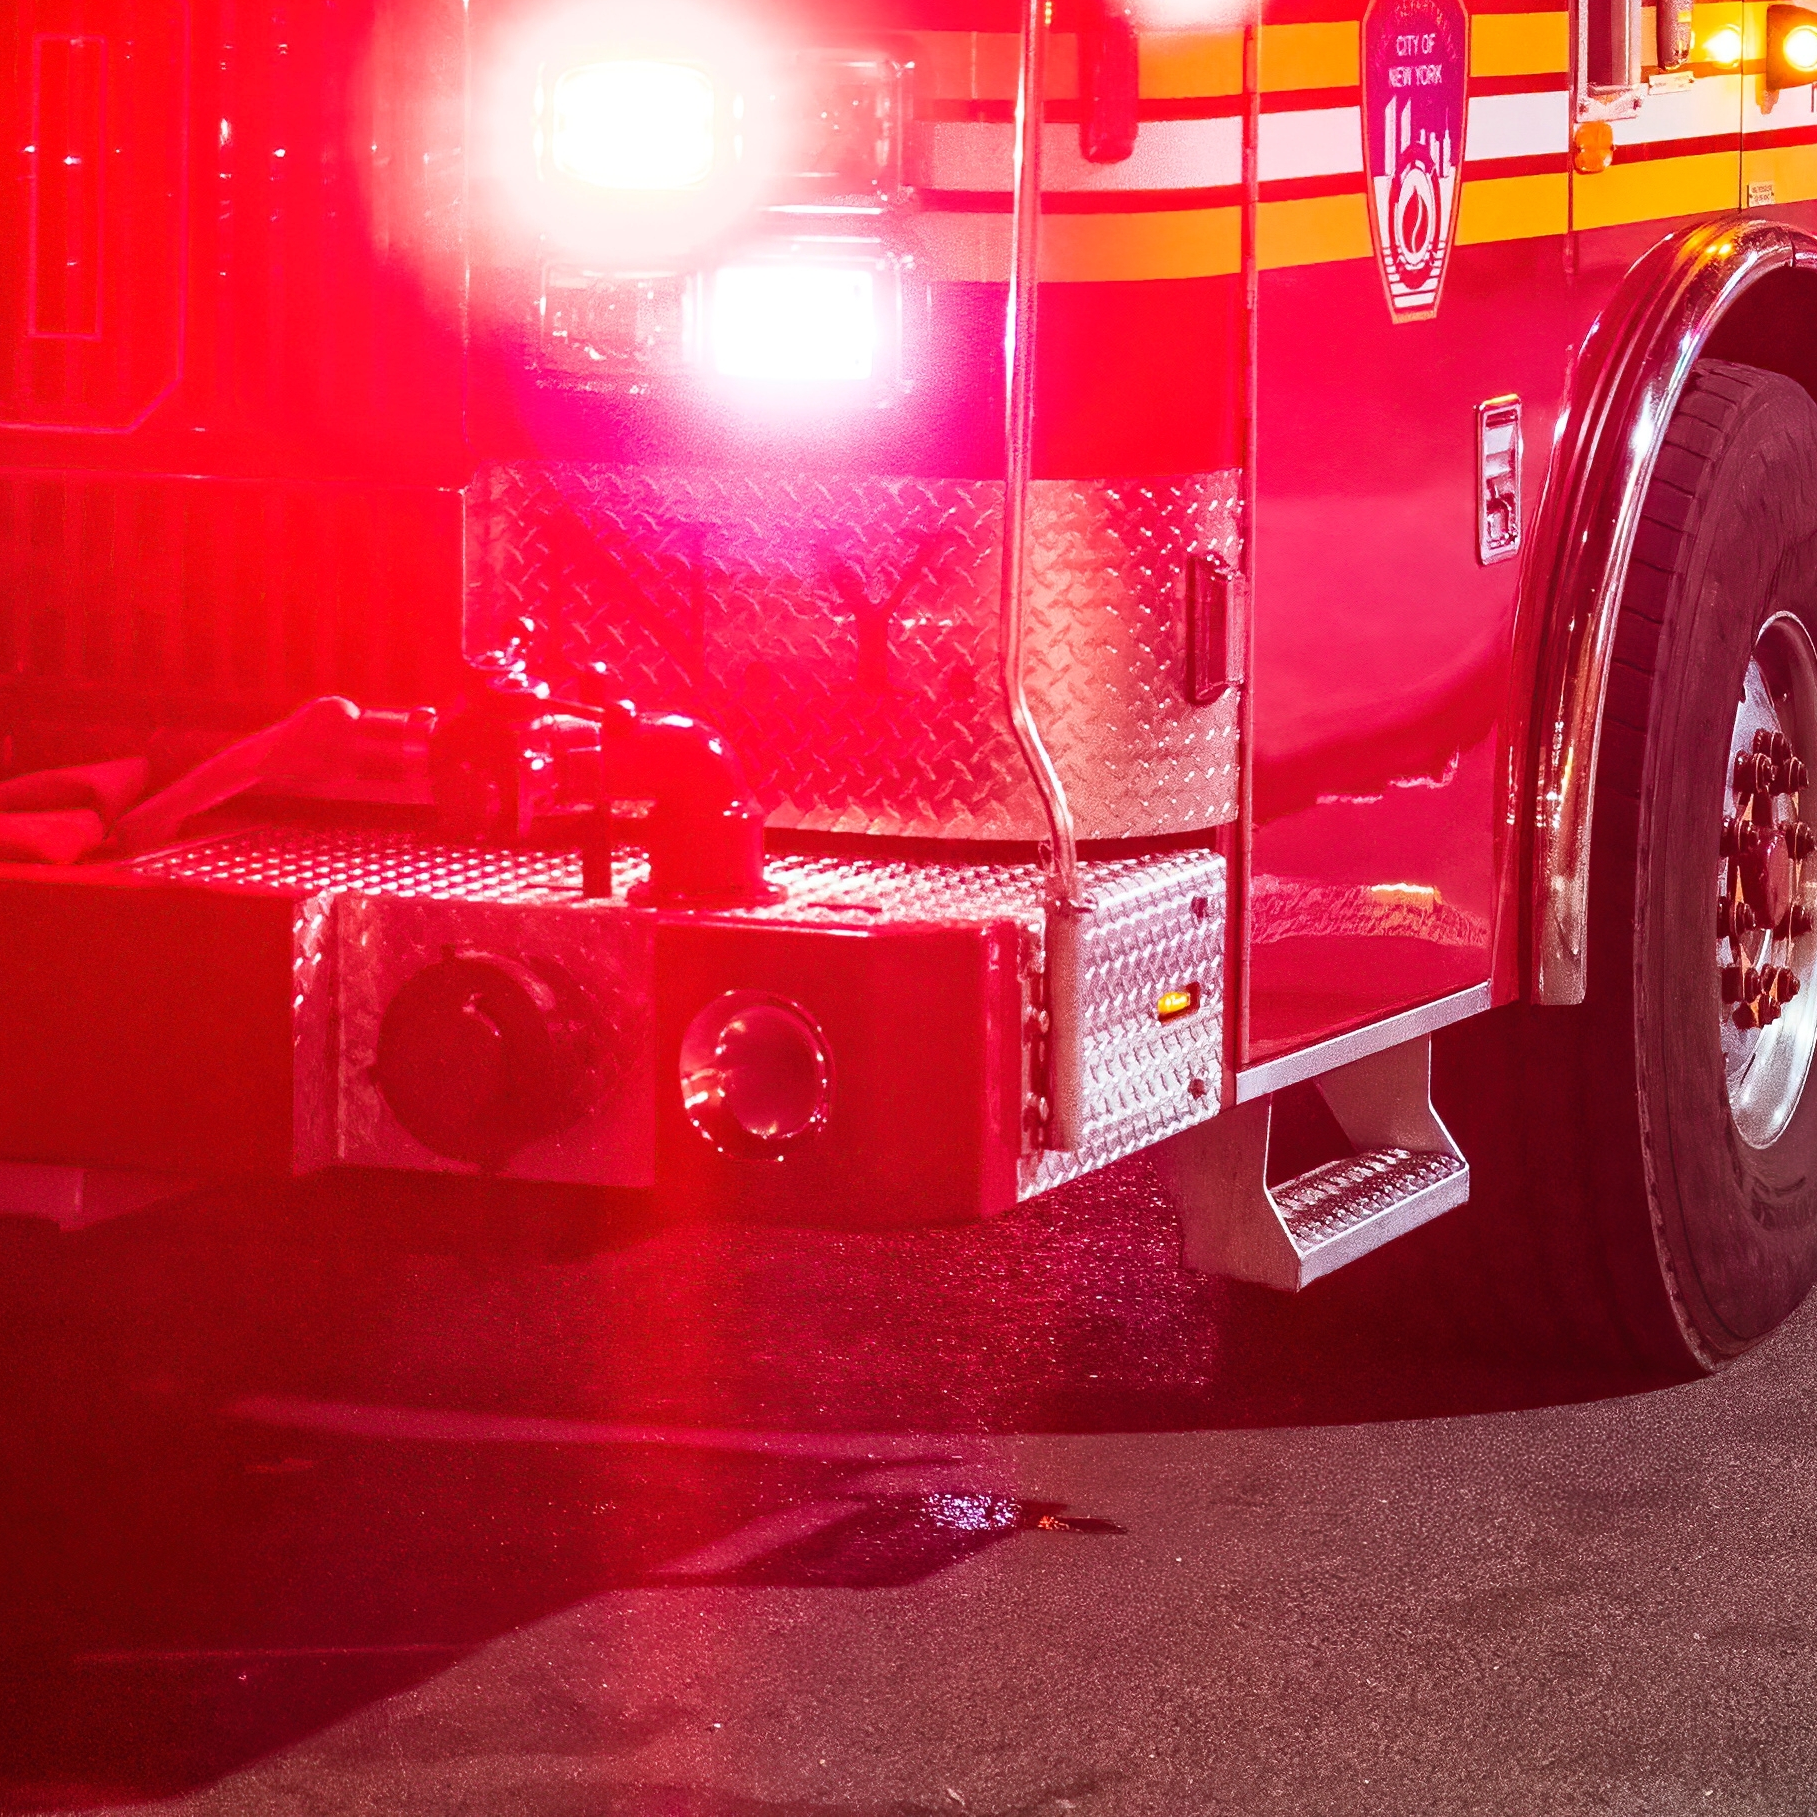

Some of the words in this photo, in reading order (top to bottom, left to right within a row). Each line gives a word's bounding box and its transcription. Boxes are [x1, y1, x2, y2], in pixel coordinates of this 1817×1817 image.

[1396, 34, 1420, 57] CITY
[1421, 33, 1437, 54] OF
[1388, 67, 1412, 88] NEW
[1415, 64, 1443, 86] YORK
